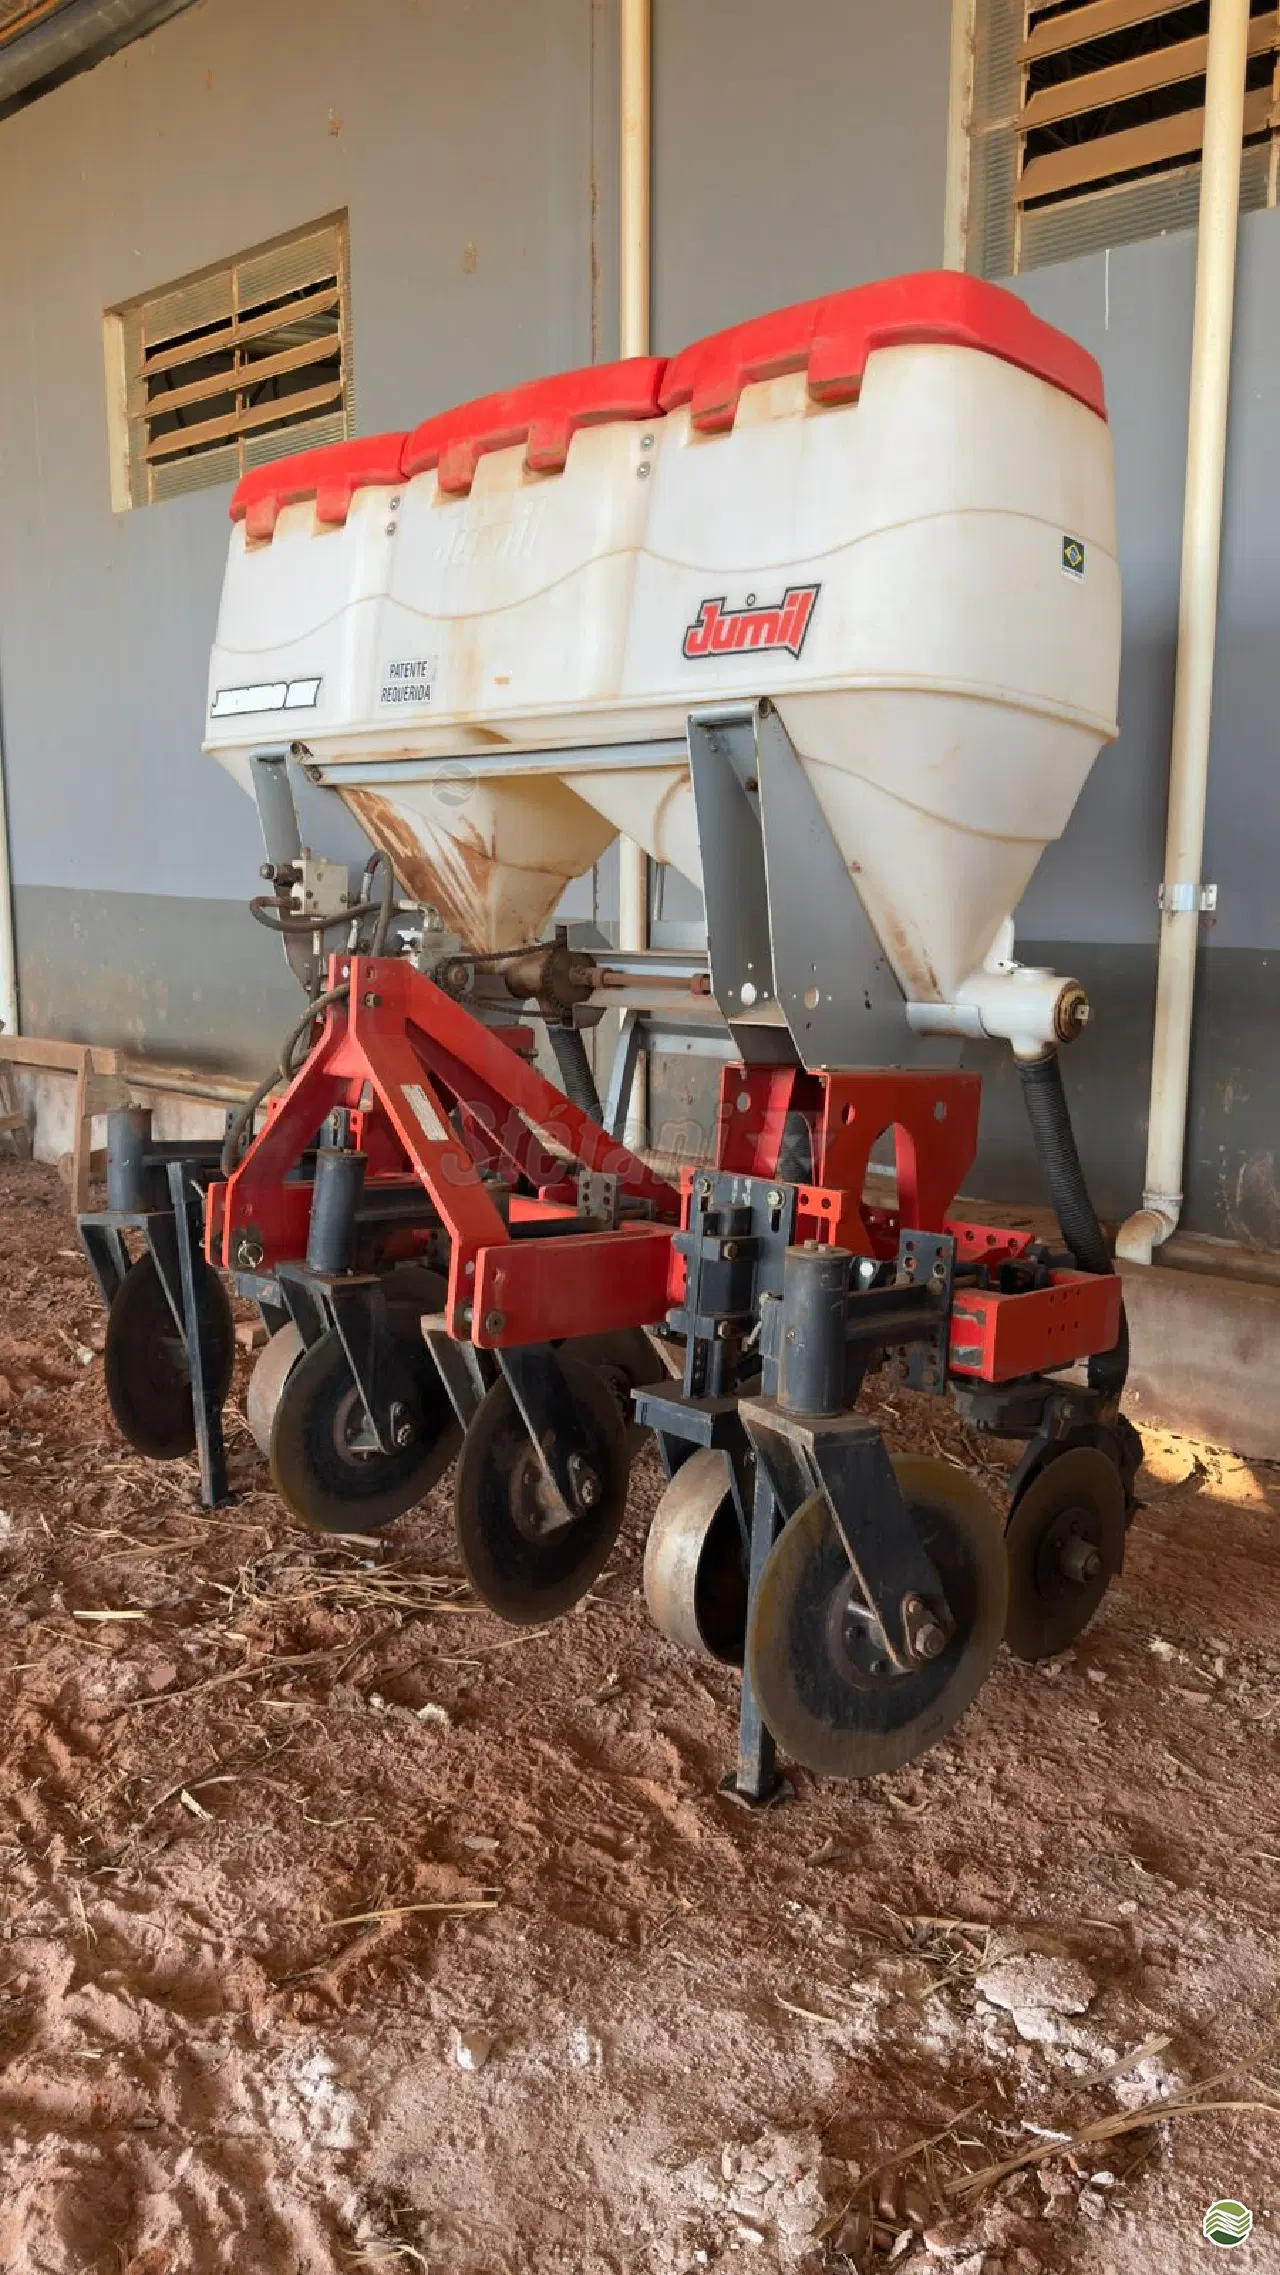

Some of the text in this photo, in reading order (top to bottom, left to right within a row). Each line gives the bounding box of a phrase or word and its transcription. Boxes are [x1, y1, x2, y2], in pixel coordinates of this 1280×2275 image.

[685, 588, 818, 657] Jumil
[389, 660, 428, 679] PATENTE
[380, 684, 431, 702] REQUERIDA
